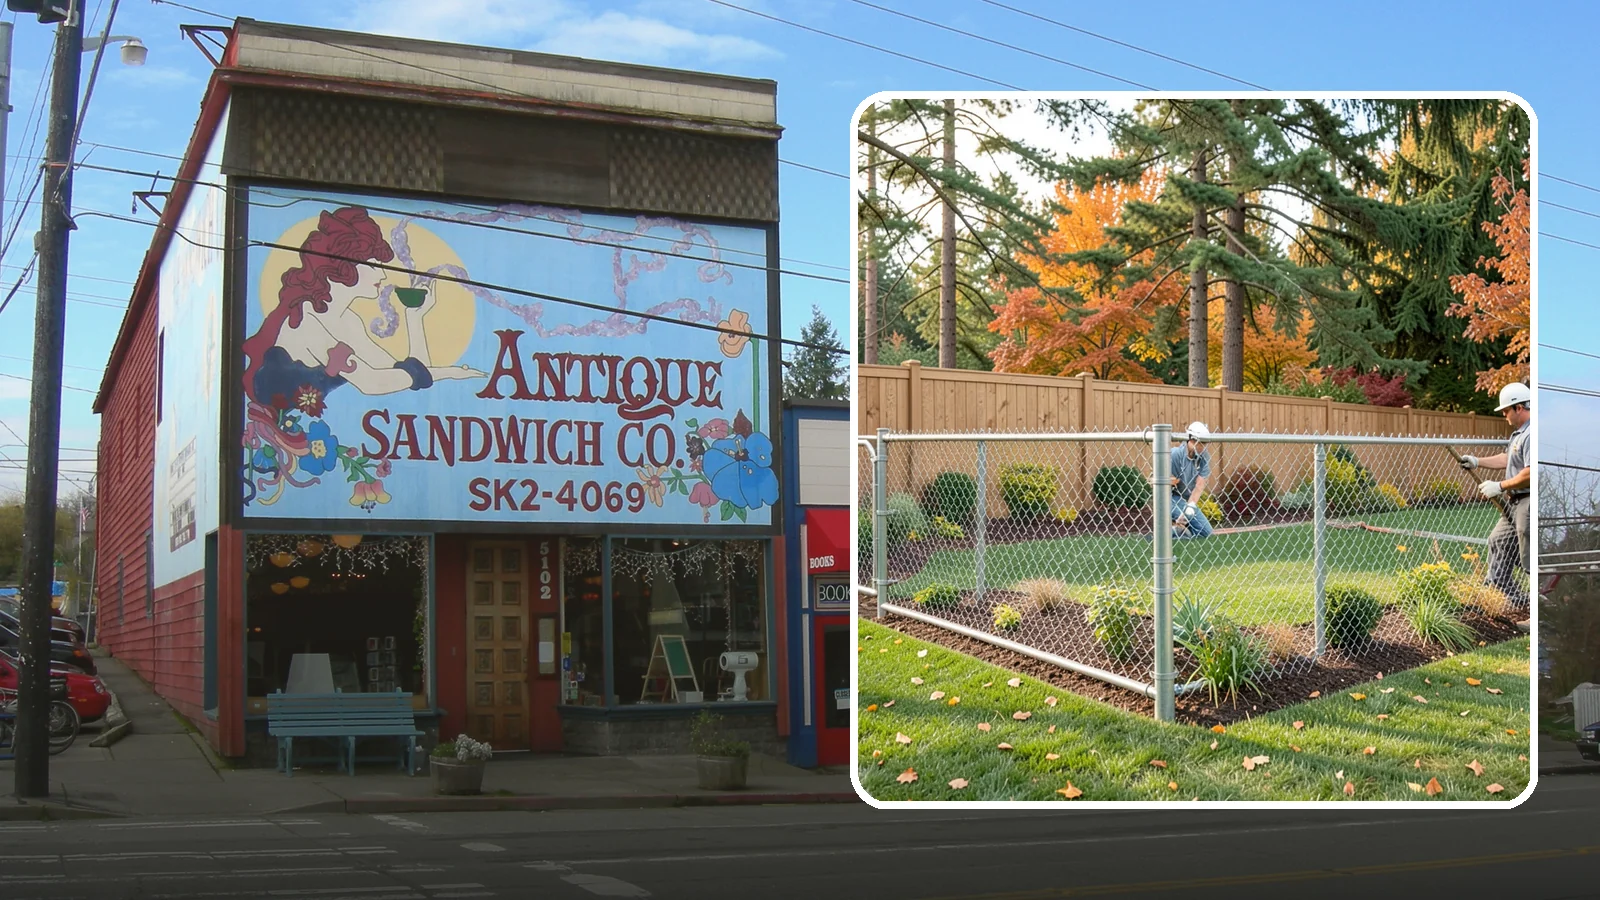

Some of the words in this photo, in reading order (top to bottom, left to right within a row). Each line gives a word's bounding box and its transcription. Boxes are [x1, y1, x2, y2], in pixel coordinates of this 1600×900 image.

[476, 329, 724, 421] ANTIQUE
[361, 408, 605, 467] SANDWICH
[616, 422, 686, 469] CO.
[468, 477, 647, 514] SK2-4069
[539, 541, 552, 600] 5102
[809, 555, 835, 569] BOOKS
